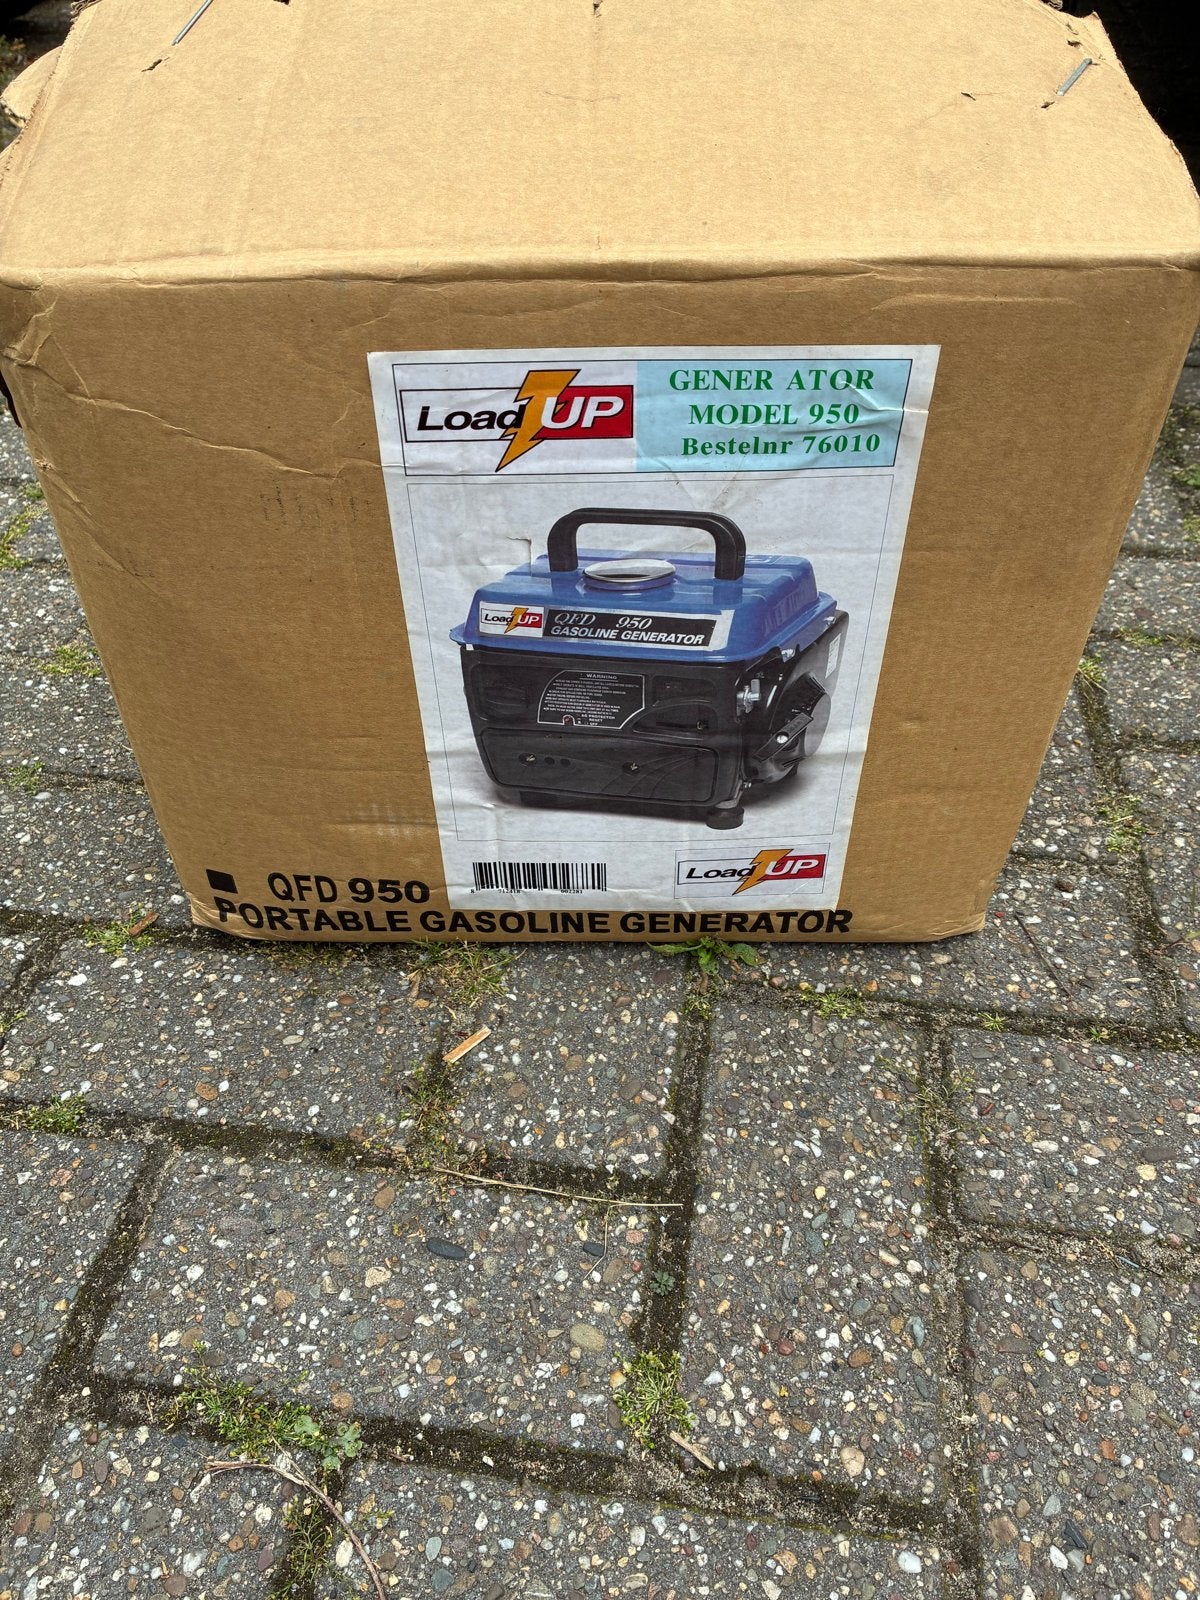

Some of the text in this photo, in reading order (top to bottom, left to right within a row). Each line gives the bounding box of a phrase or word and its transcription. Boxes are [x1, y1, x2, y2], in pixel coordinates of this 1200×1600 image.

[417, 395, 626, 432] Load UP
[688, 403, 860, 426] MODEL 950
[681, 433, 880, 457] Bestelnr 76010
[484, 613, 540, 625] Load UP
[554, 612, 652, 631] QFD 950
[550, 626, 705, 645] GASOLINE GENERATOR
[686, 858, 819, 881] Load UP
[267, 872, 430, 904] QFD 950
[213, 896, 853, 934] PORTABLE GASOLINE GENERATOR
